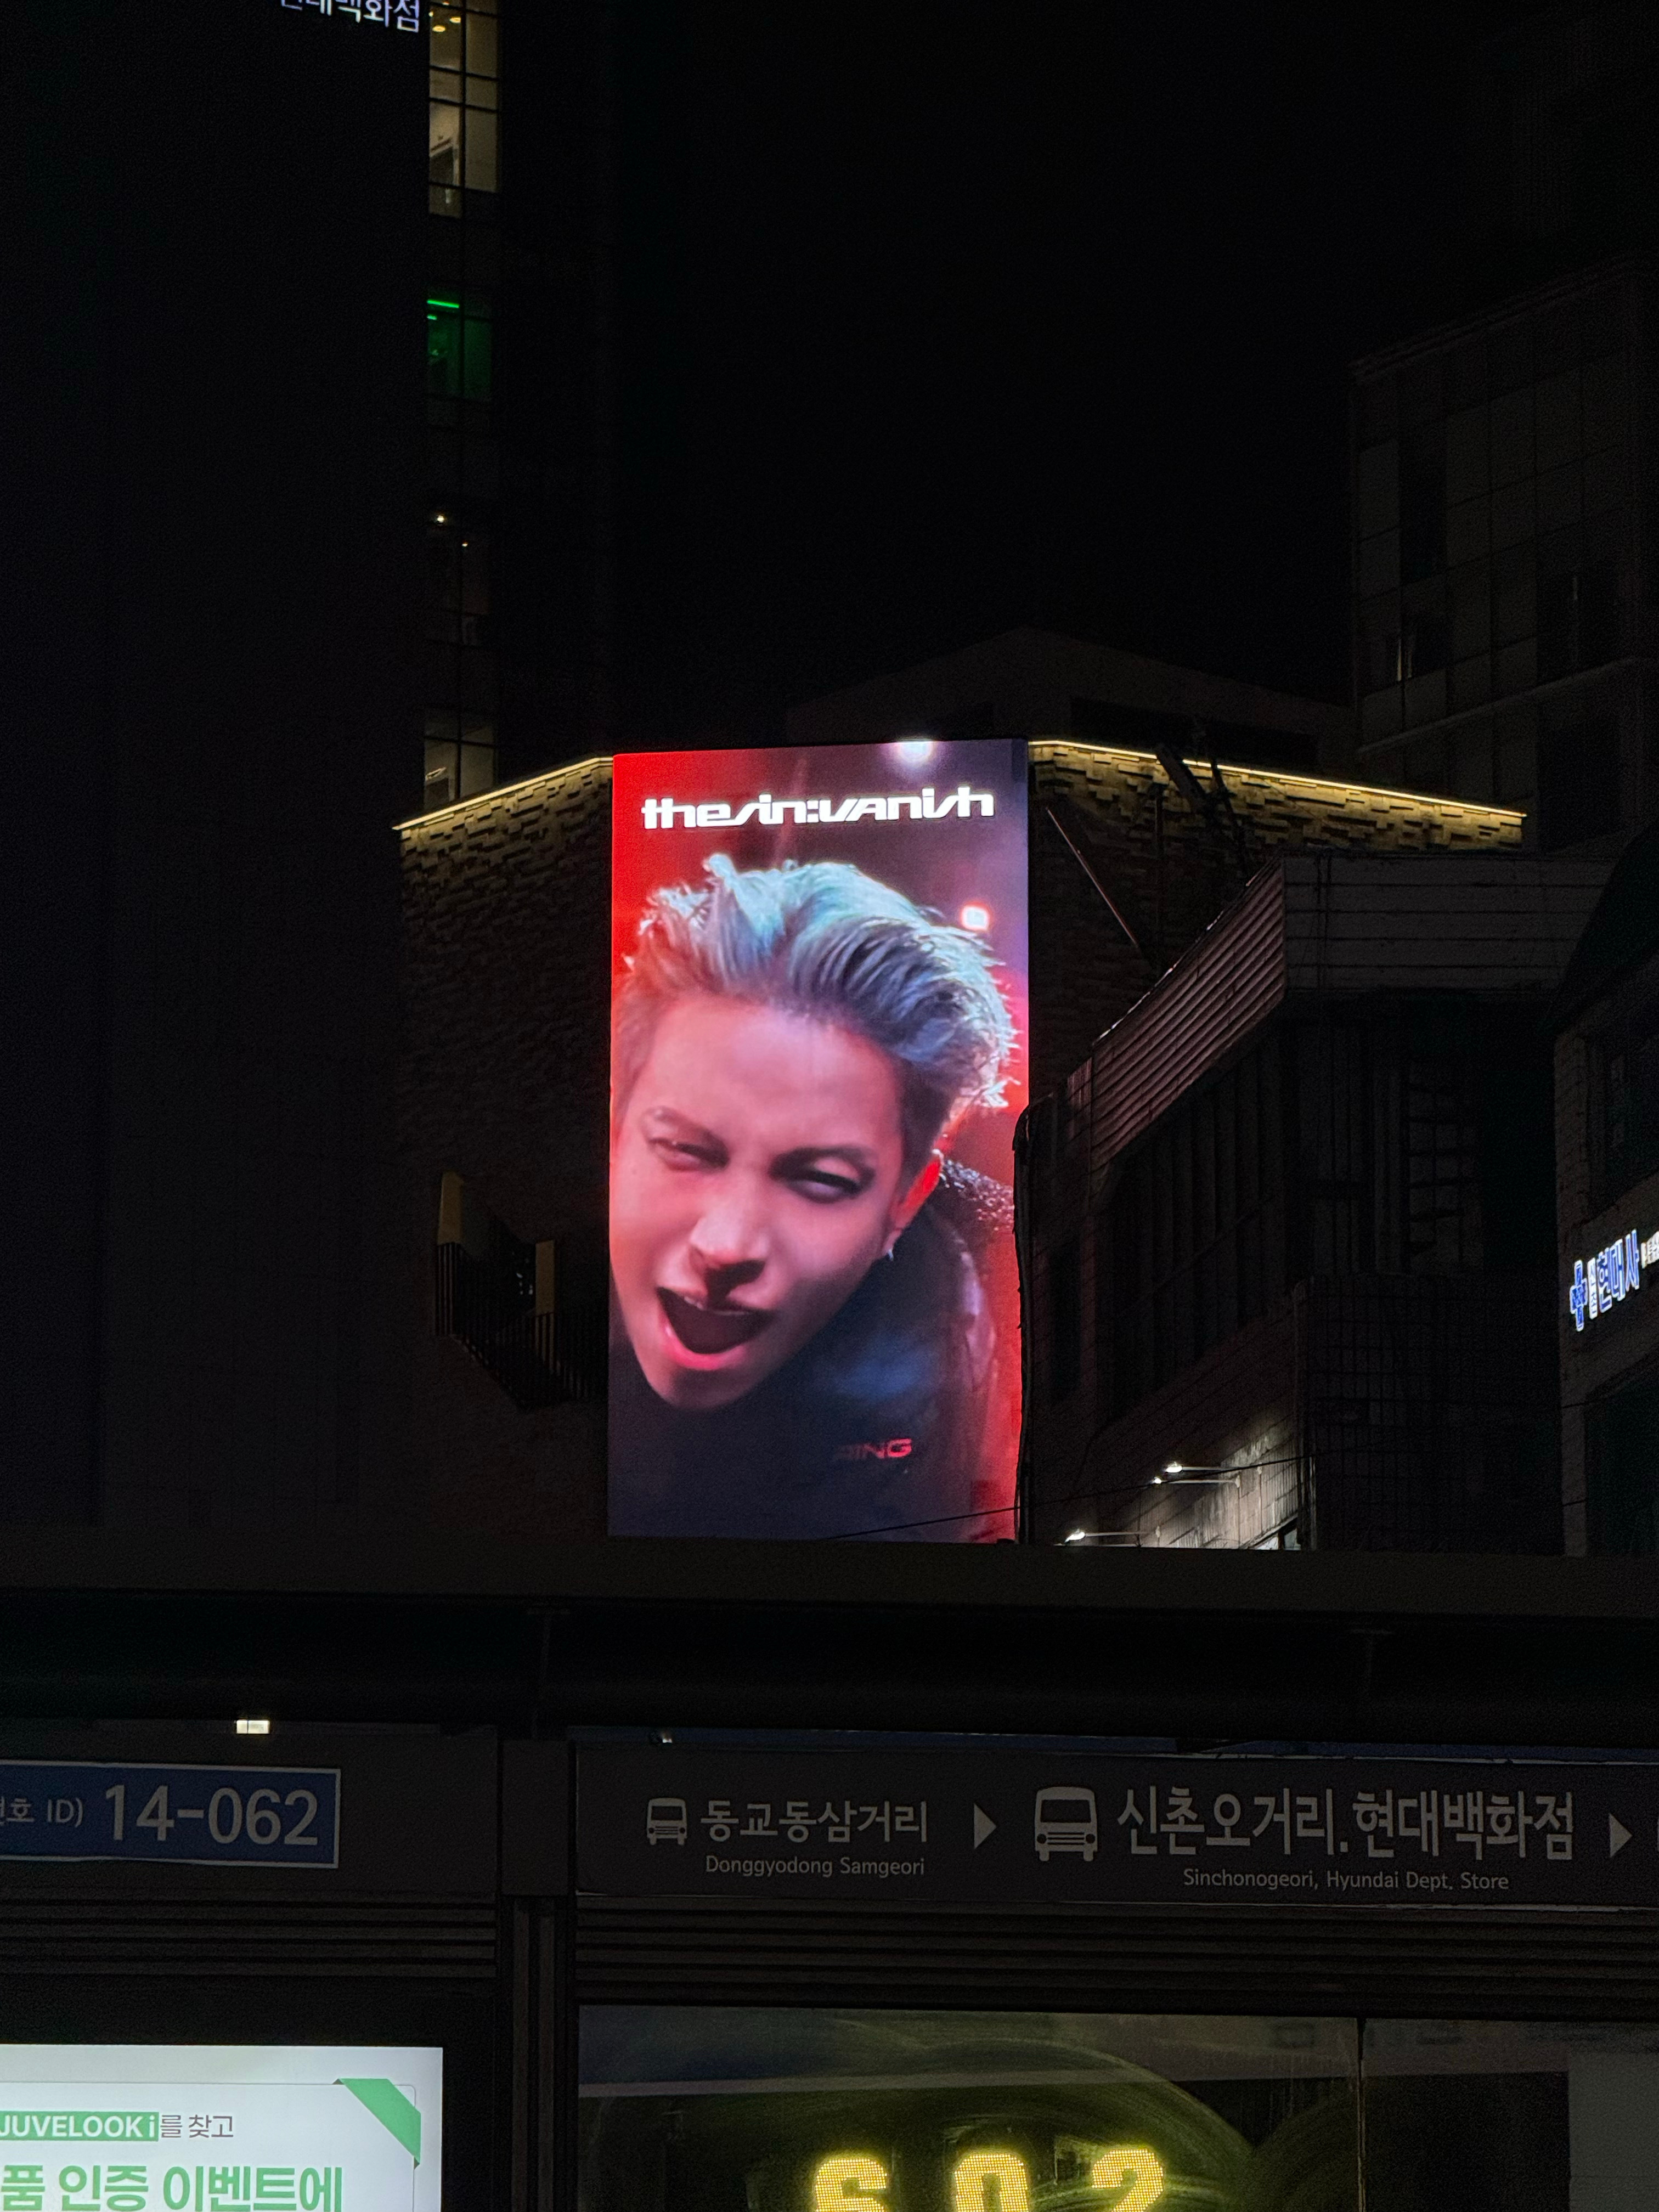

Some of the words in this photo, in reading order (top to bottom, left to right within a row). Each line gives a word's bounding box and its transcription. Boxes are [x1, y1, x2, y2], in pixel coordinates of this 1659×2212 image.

[280, 0, 420, 33] 백화점
[0, 1796, 35, 1826] 호
[47, 1797, 83, 1828] ID)
[105, 1784, 318, 1846] 14-062
[701, 1799, 928, 1843] 동교동삼거리
[706, 1855, 833, 1877] Donggyodong
[840, 1857, 925, 1878] Samgeori
[1183, 1868, 1318, 1890] Sinchonogeori,
[1326, 1870, 1399, 1891] Hyundai
[1406, 1871, 1454, 1892] Dept.
[1460, 1872, 1509, 1889] Store
[0, 2115, 143, 2137] JUVELOOK
[189, 2114, 234, 2138] 찾고
[1, 2165, 46, 2211] 품
[59, 2165, 149, 2211] 인증
[163, 2166, 343, 2212] 이벤트에
